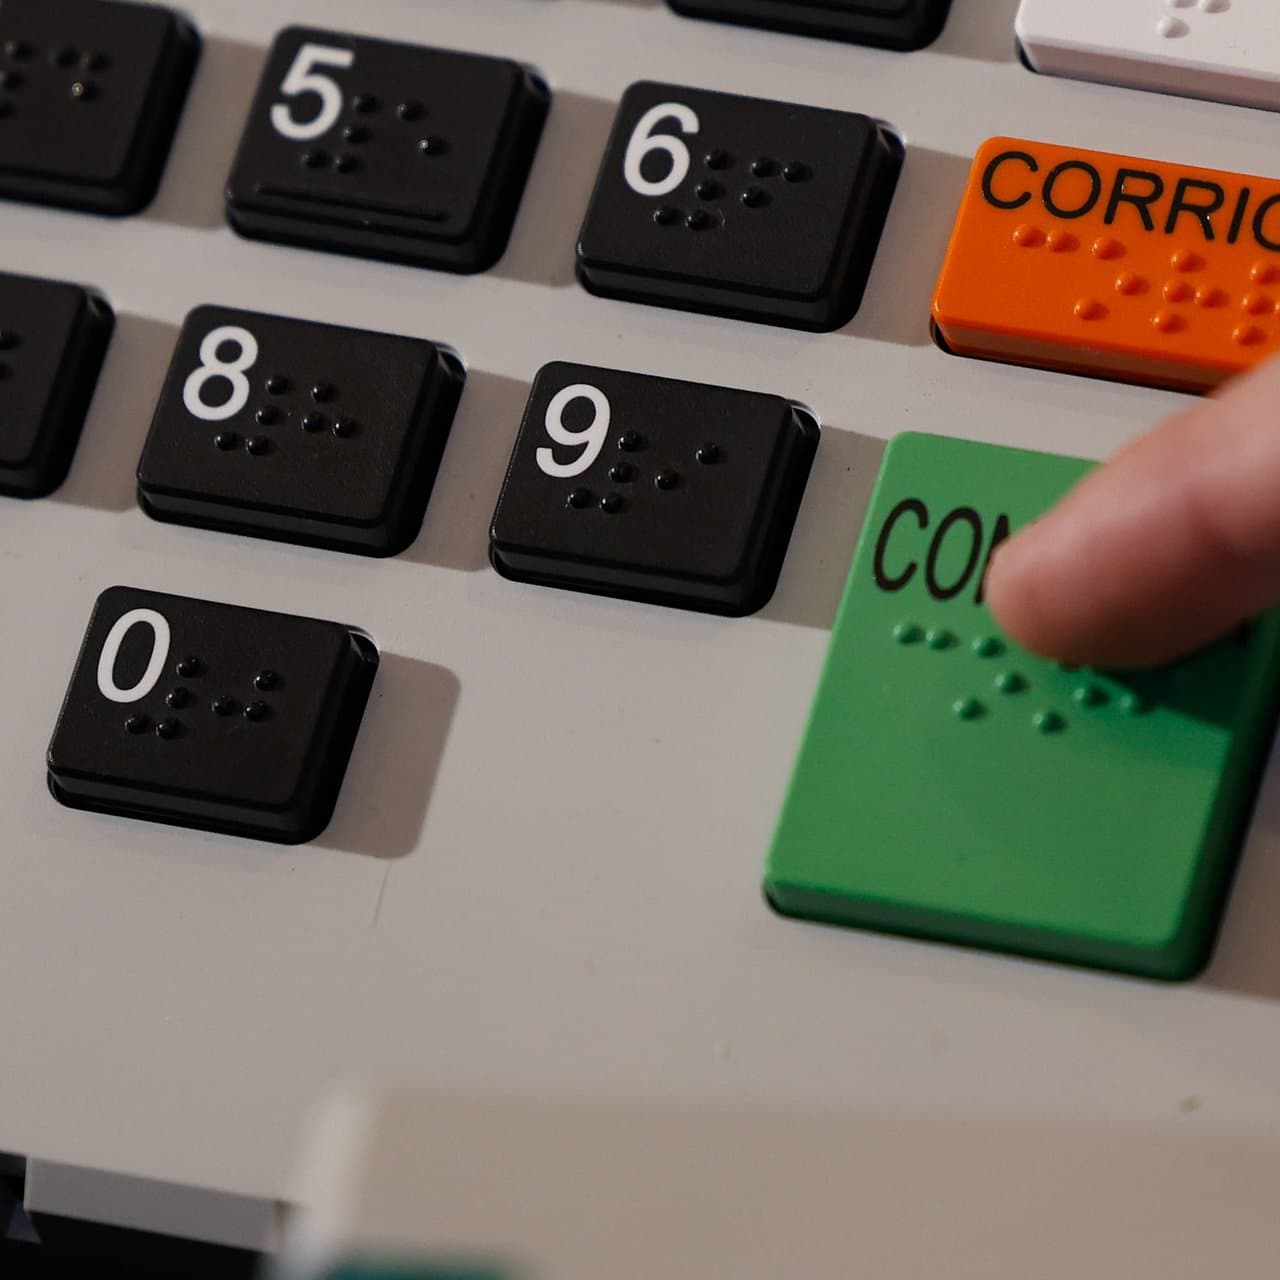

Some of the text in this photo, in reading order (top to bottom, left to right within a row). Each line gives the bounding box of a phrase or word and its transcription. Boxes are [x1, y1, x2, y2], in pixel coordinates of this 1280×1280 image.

[272, 45, 353, 139] 5
[624, 103, 699, 196] 6
[183, 326, 258, 420] 8
[536, 384, 610, 477] 9
